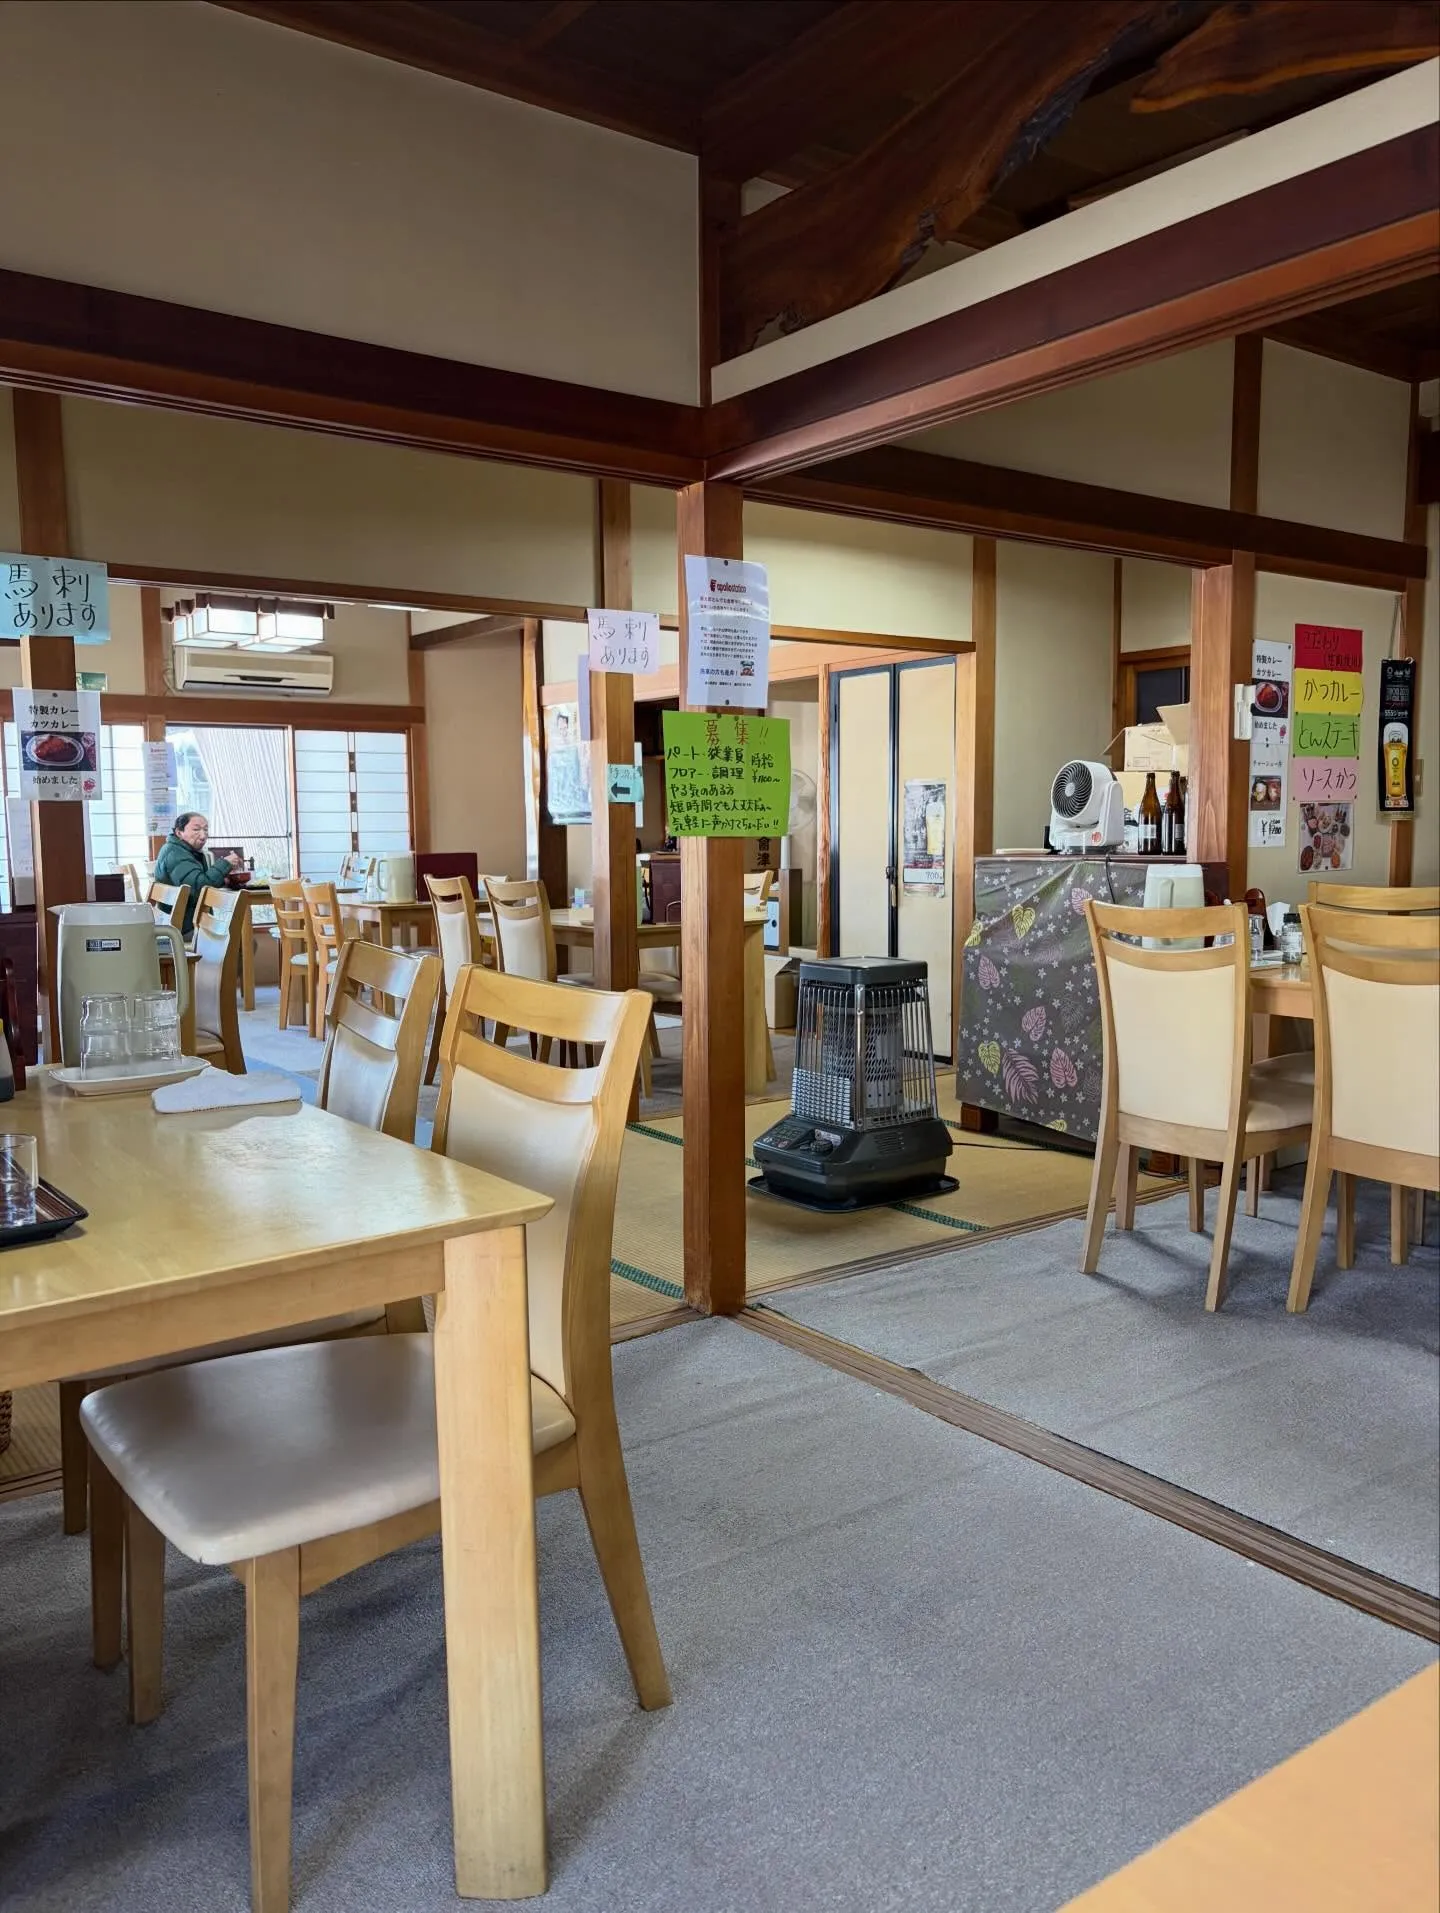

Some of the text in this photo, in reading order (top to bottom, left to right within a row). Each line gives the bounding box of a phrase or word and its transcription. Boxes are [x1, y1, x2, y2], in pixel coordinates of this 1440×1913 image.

[4, 563, 90, 602] 馬刺
[13, 602, 97, 631] あります
[600, 645, 650, 669] あります
[1256, 667, 1282, 678] カツカレー
[1303, 677, 1361, 702] かつカレー
[28, 704, 80, 715] 特製カレー
[31, 719, 81, 729] カツカレー
[1298, 719, 1359, 751] とんステーキ
[751, 753, 774, 769] 時給
[33, 775, 78, 785] 始めました
[1303, 767, 1357, 793] ソースかつ
[670, 783, 735, 799] やる気のある方
